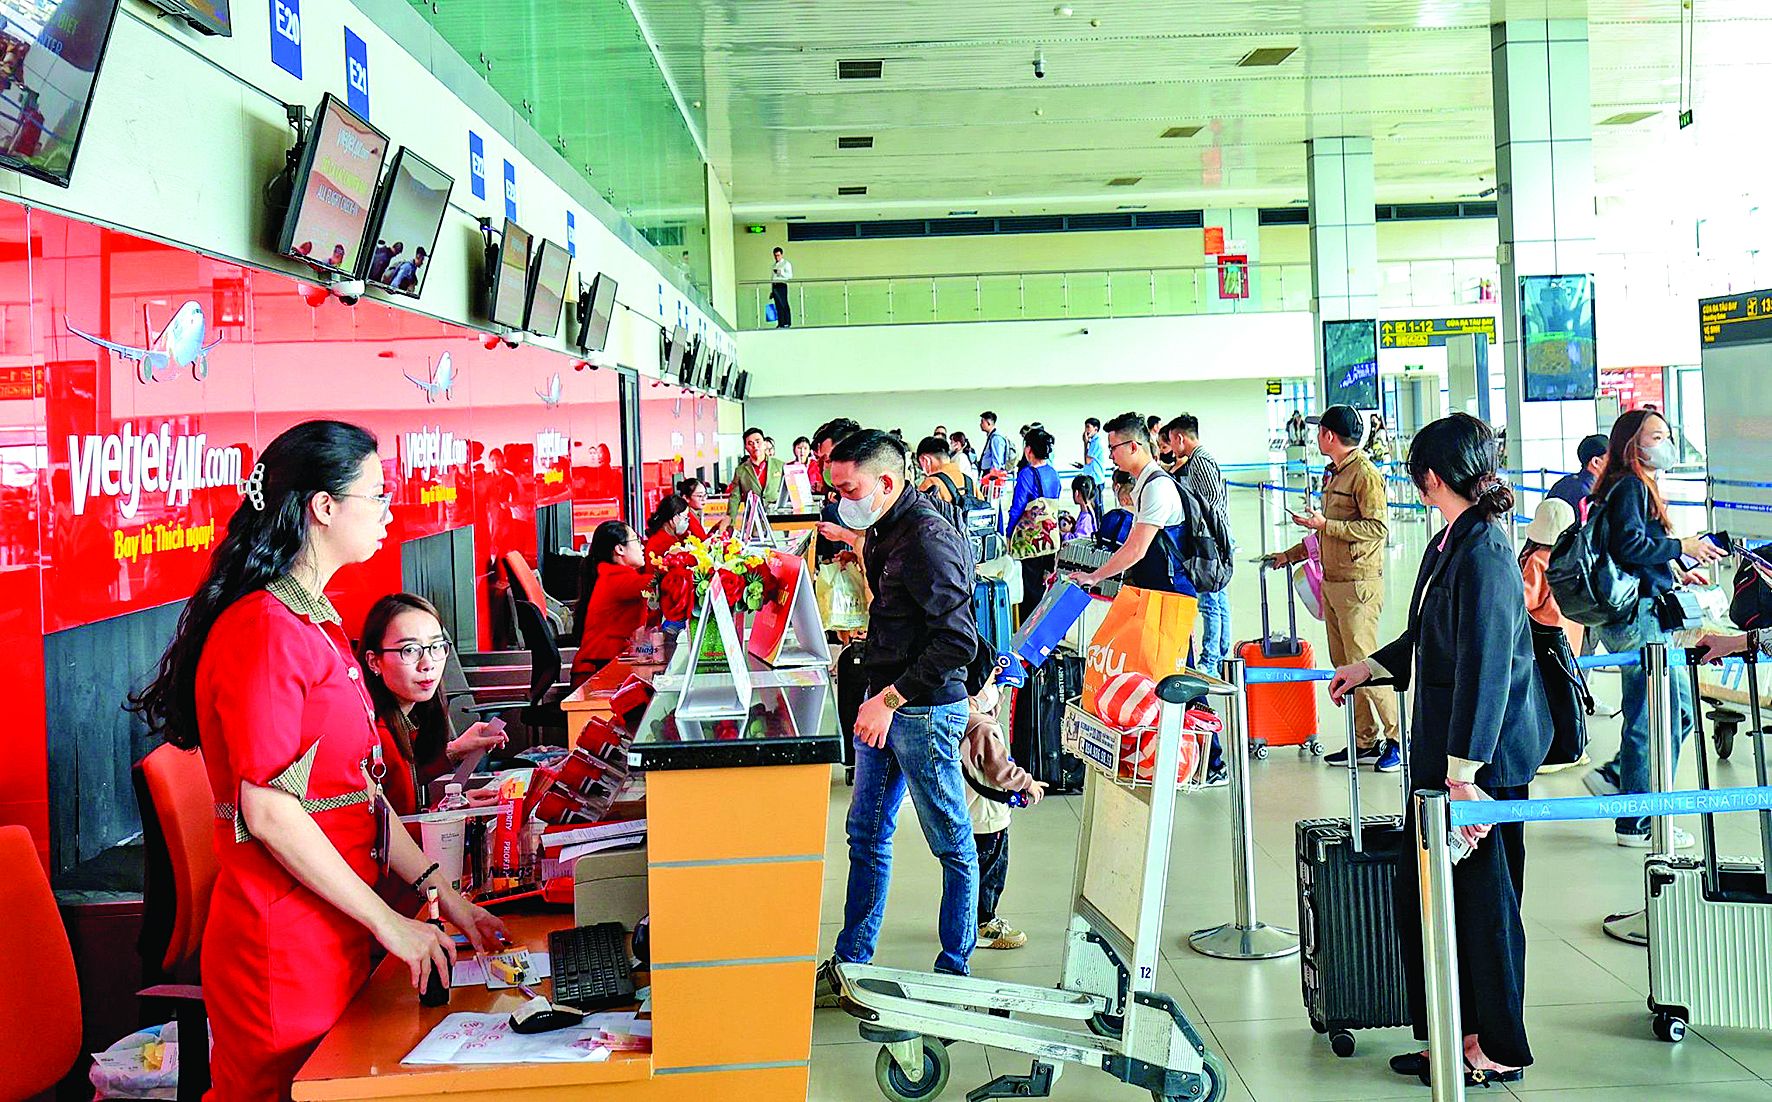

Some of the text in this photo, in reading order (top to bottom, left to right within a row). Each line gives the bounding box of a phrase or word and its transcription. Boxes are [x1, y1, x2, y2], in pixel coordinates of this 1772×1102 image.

[275, 0, 300, 45] E20
[349, 56, 367, 95] E21
[1408, 320, 1434, 333] 1-12
[114, 517, 215, 564] Bay là Thích ngay!
[1658, 793, 1772, 813] INTERNATION
[1140, 966, 1151, 978] T2
